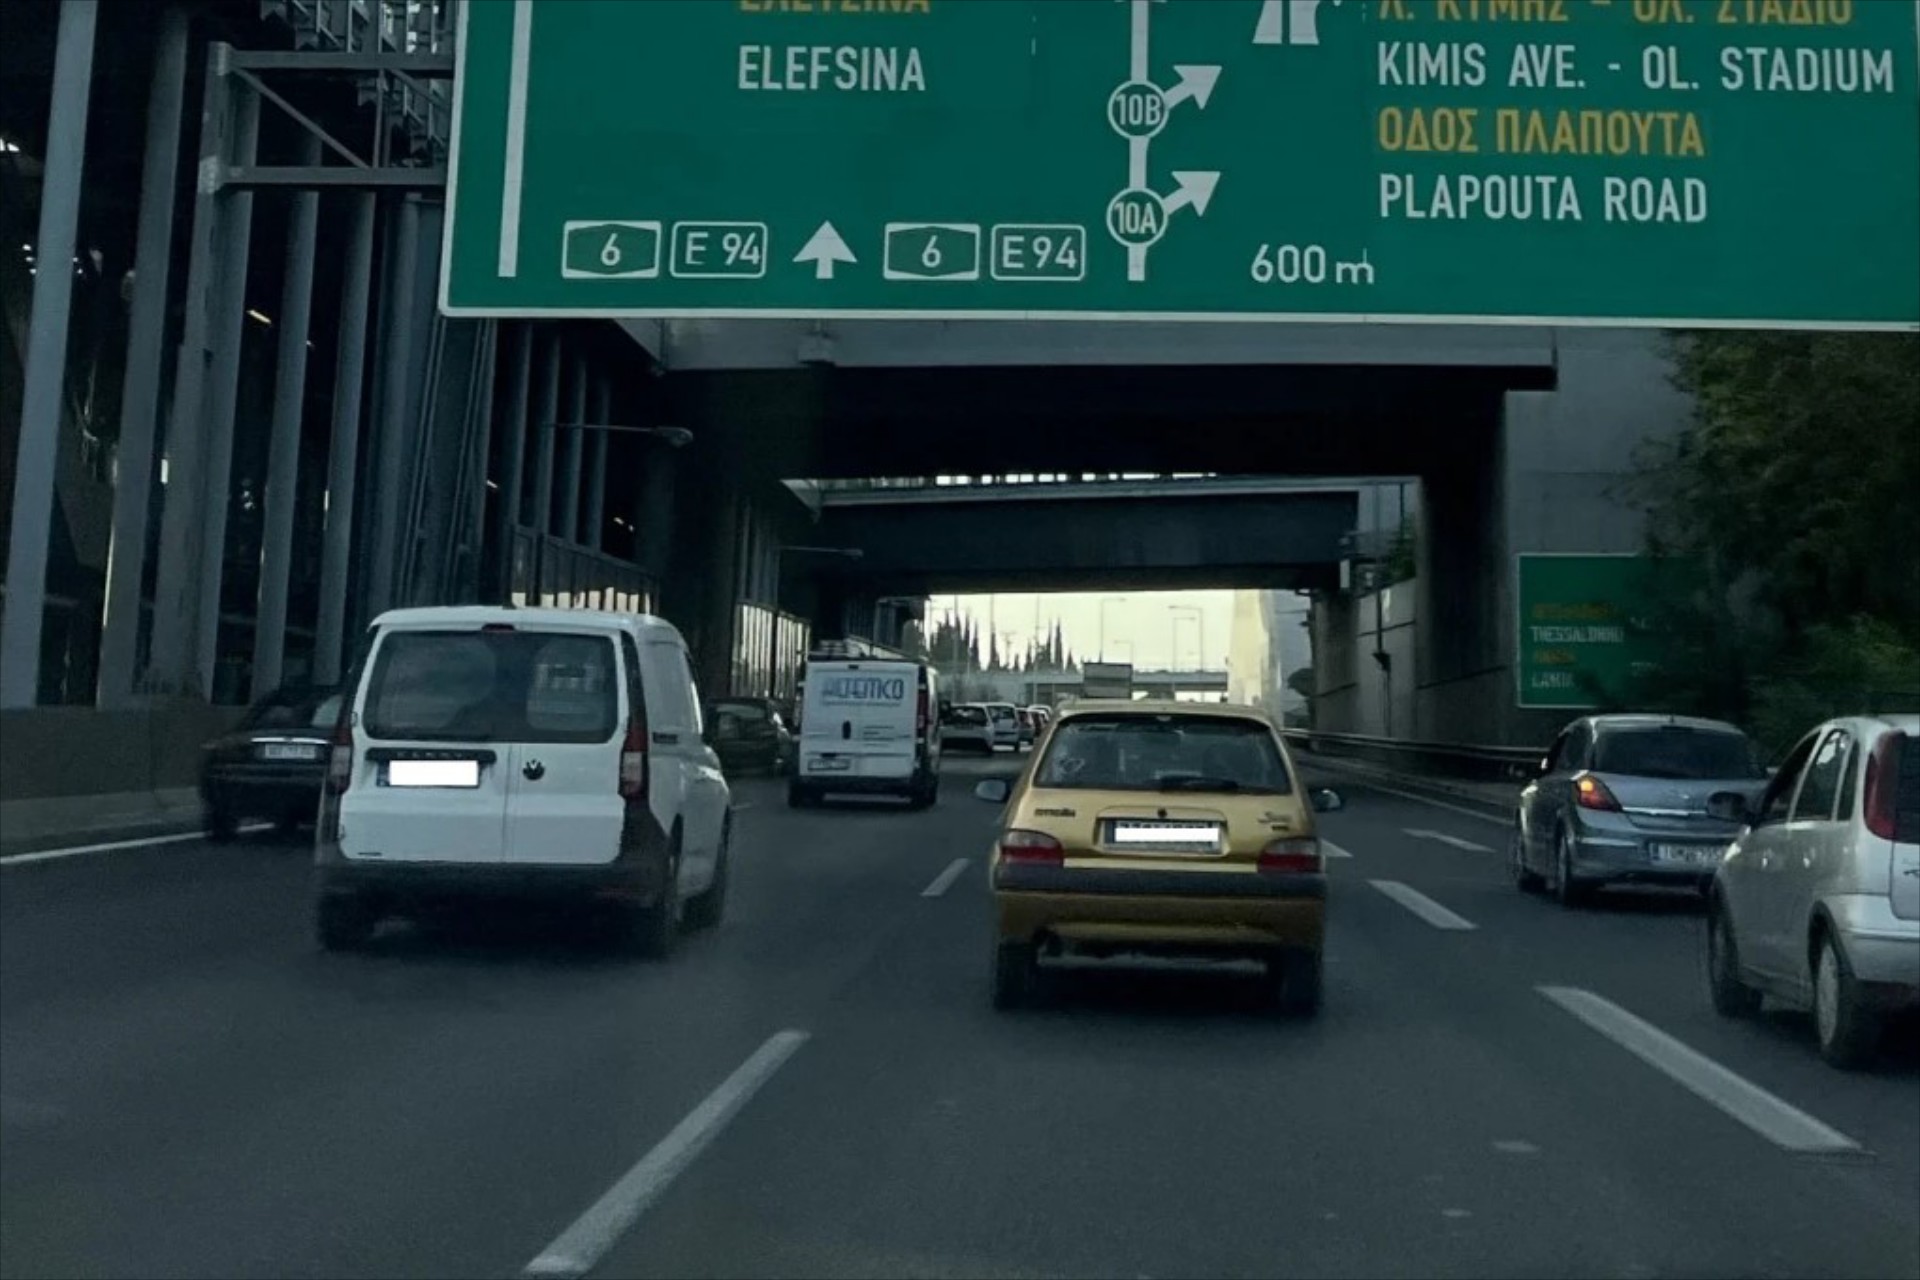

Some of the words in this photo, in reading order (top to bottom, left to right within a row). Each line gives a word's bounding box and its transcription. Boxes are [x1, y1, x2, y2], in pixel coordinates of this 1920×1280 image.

[738, 45, 926, 91] ELEFSINA
[1378, 41, 1486, 86] KIMIS
[1508, 44, 1586, 88] AVE.
[1642, 45, 1699, 90] OL.
[1720, 46, 1894, 93] STADIUM
[1115, 94, 1161, 126] 10B
[1378, 107, 1479, 153] ΟΔΟΣ
[1497, 108, 1705, 157] ΠΛΑΠΟΥΤΑ
[1380, 173, 1582, 221] PLAPOUTA
[1604, 176, 1708, 222] ROAD
[1114, 202, 1157, 234] 10A
[601, 232, 621, 266] 6
[685, 231, 709, 265] E
[722, 232, 761, 266] 94
[922, 234, 942, 268] 6
[1002, 235, 1025, 268] E
[1032, 236, 1077, 269] 94
[1251, 244, 1326, 283] 600
[1336, 260, 1374, 284] m
